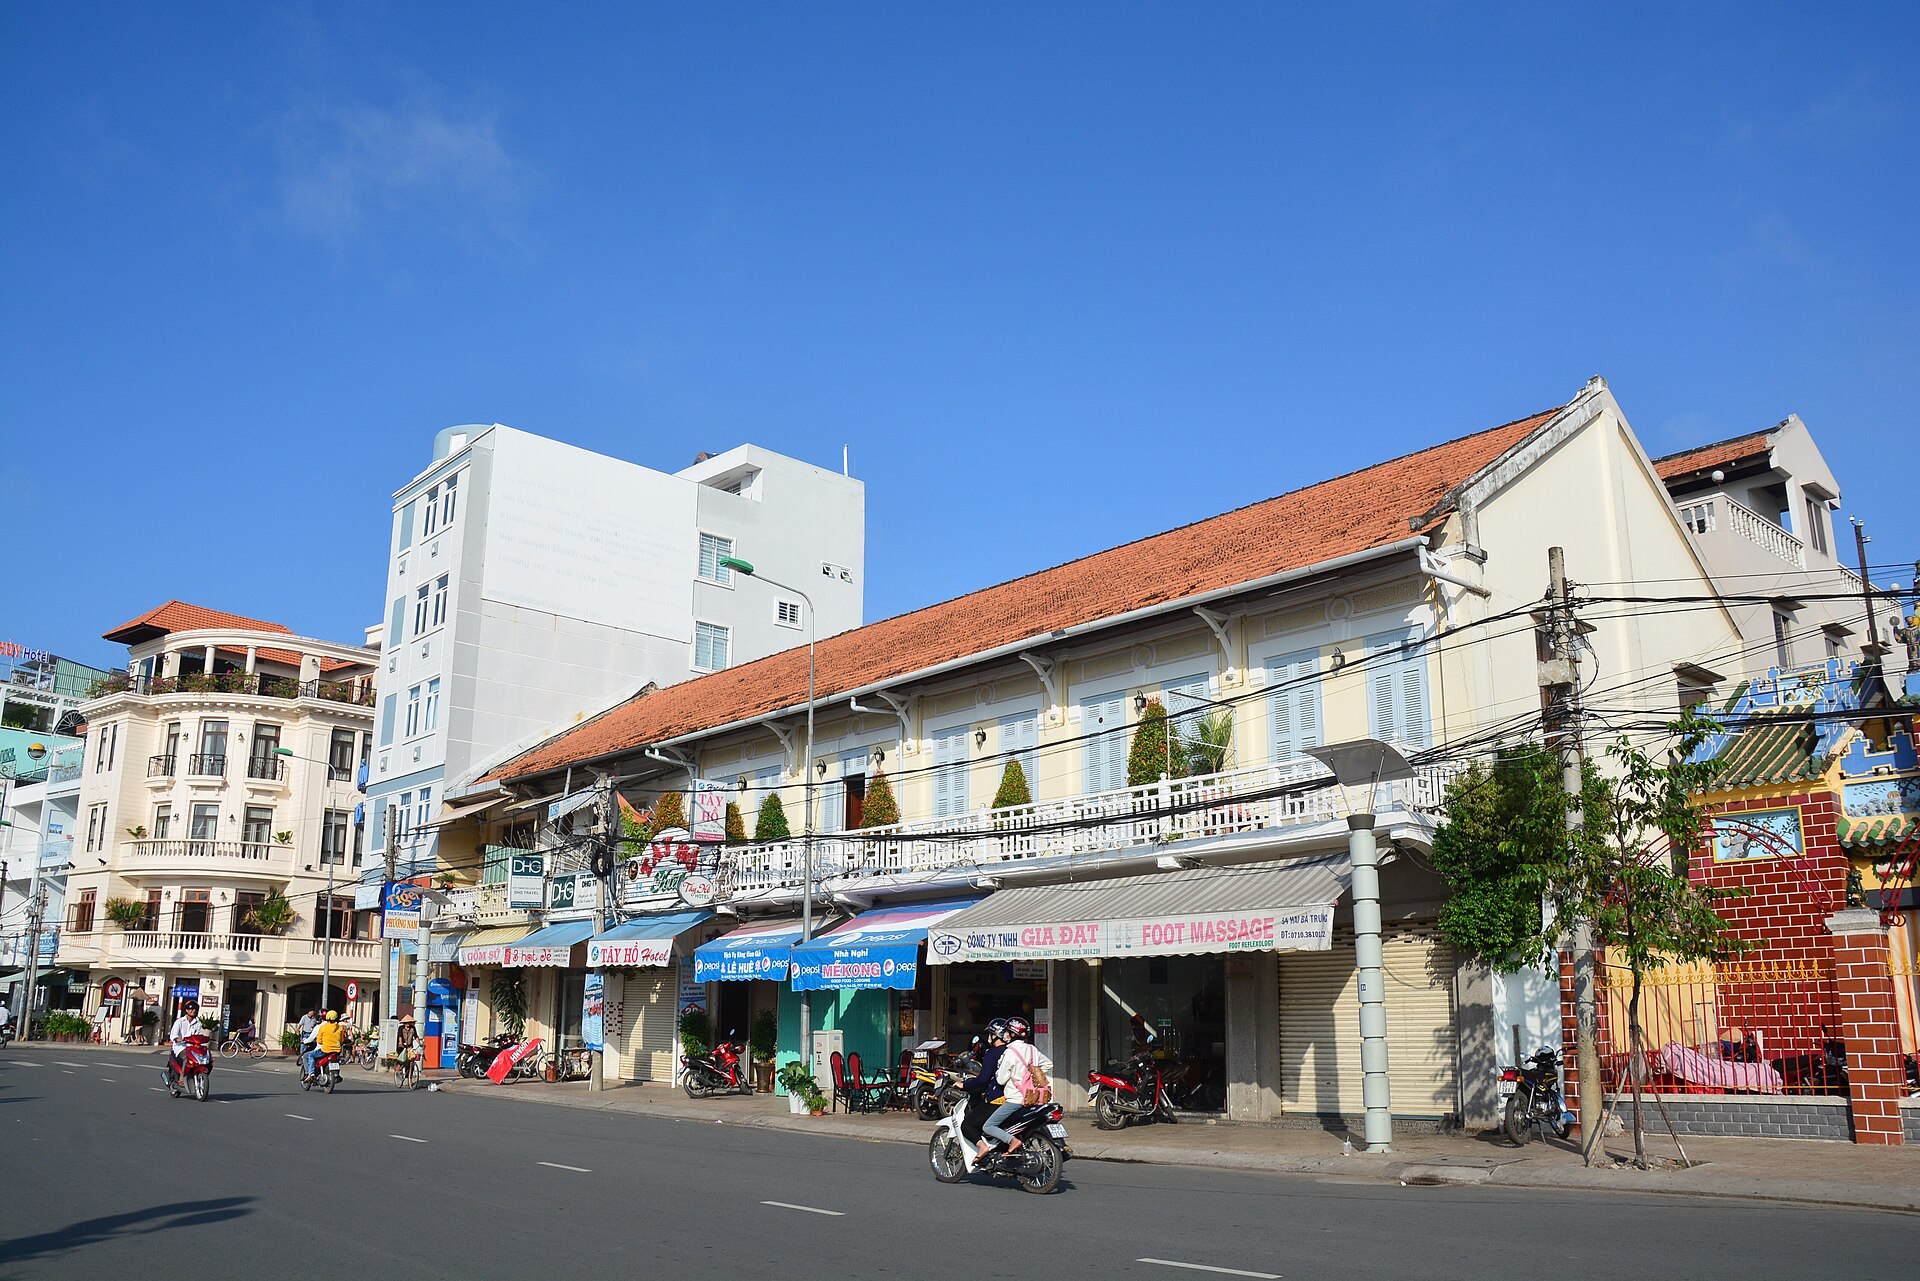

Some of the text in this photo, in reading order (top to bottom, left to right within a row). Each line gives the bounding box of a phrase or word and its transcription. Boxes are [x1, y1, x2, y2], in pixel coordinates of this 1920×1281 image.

[23, 647, 50, 663] Hotel
[699, 792, 723, 807] TÂY
[513, 860, 541, 873] DHG
[553, 882, 573, 902] DHG
[407, 919, 418, 929] NAM
[1142, 917, 1275, 946] FOOT MASSAGE
[966, 931, 1018, 949] CÔNG TY TNHH
[1021, 924, 1099, 948] GIA ĐẠT
[467, 947, 486, 961] GỐM
[601, 941, 669, 963] TÂY HỒ Hotel
[834, 949, 849, 957] Nhà
[703, 960, 720, 972] pepsi
[728, 960, 737, 973] LÊ
